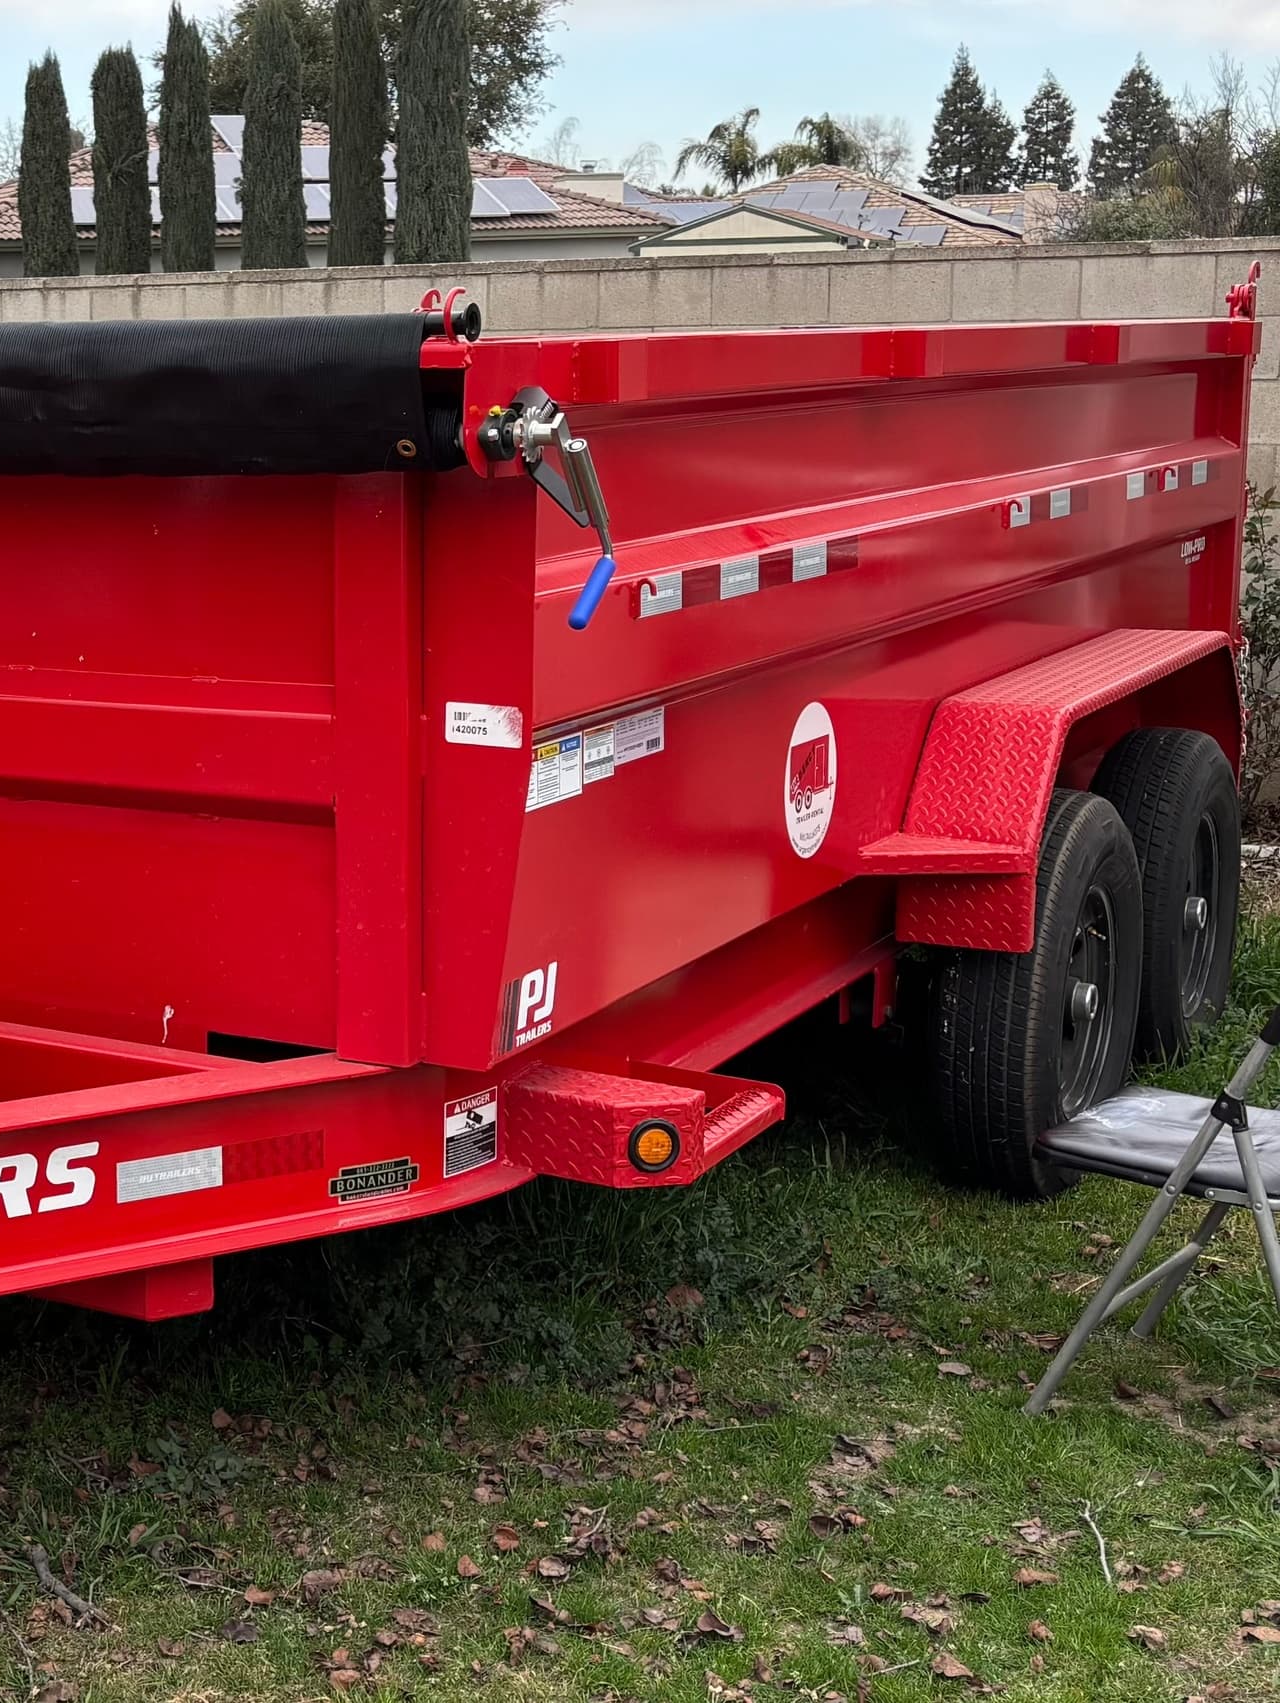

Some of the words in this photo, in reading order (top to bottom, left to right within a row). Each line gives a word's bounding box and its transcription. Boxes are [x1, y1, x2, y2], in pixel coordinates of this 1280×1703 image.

[517, 961, 558, 1030] PJ
[515, 1019, 552, 1048] TRAILERS
[461, 1092, 490, 1111] DANGER
[153, 1165, 201, 1182] TRAILERS
[336, 1168, 413, 1192] BONANDER
